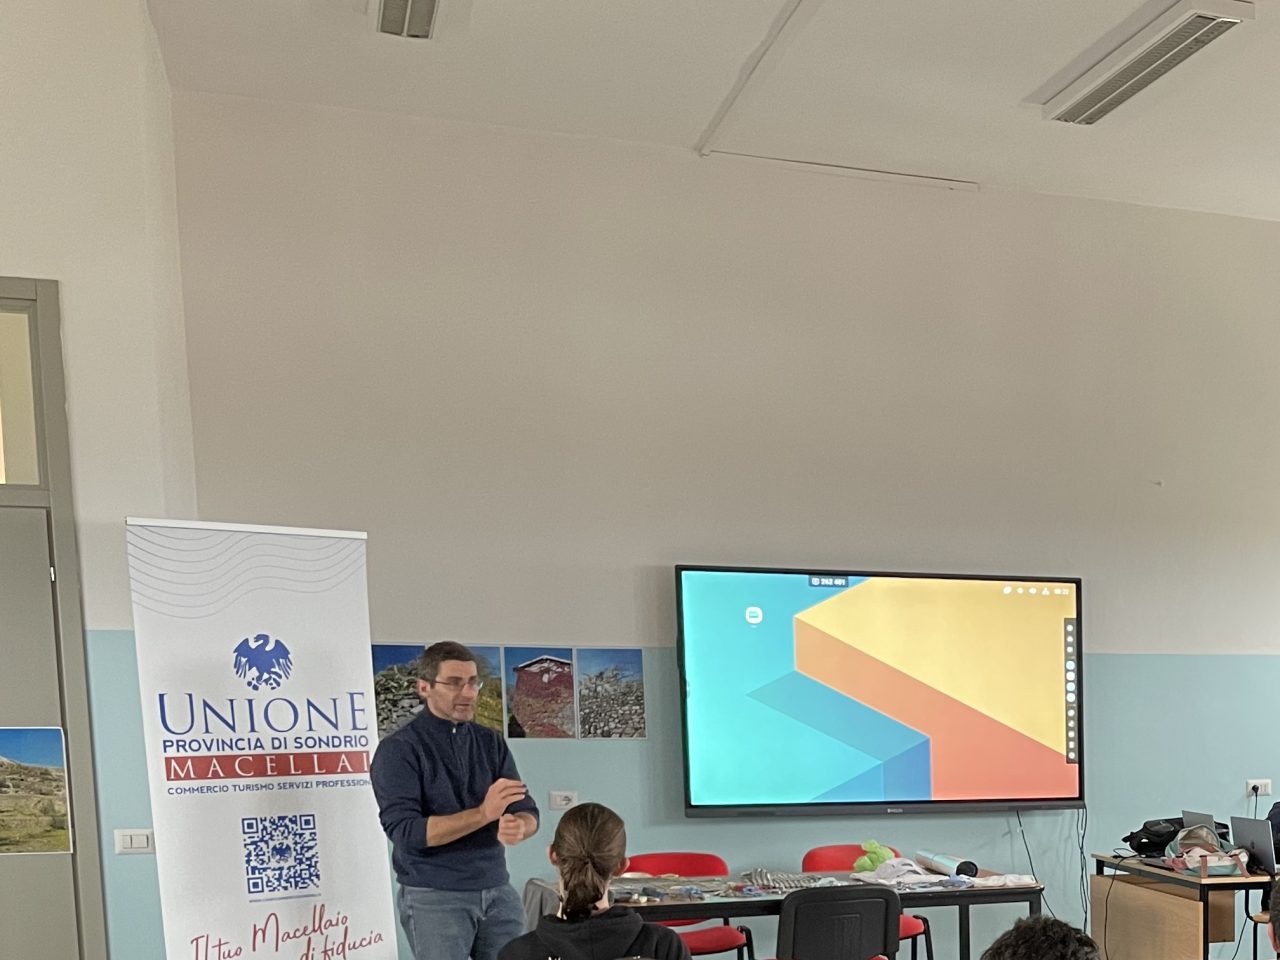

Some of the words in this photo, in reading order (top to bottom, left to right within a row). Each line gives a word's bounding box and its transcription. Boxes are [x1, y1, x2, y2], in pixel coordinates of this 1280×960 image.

[158, 692, 369, 735] UNIONE
[162, 737, 265, 753] PROVINCIA
[271, 737, 288, 750] DI
[294, 735, 369, 750] SONDRIO
[169, 752, 369, 779] MACELLAI
[167, 785, 229, 795] COMMERCIO
[233, 782, 274, 792] TURISMO
[277, 781, 313, 790] SERVIZI
[252, 903, 348, 952] Macellaio
